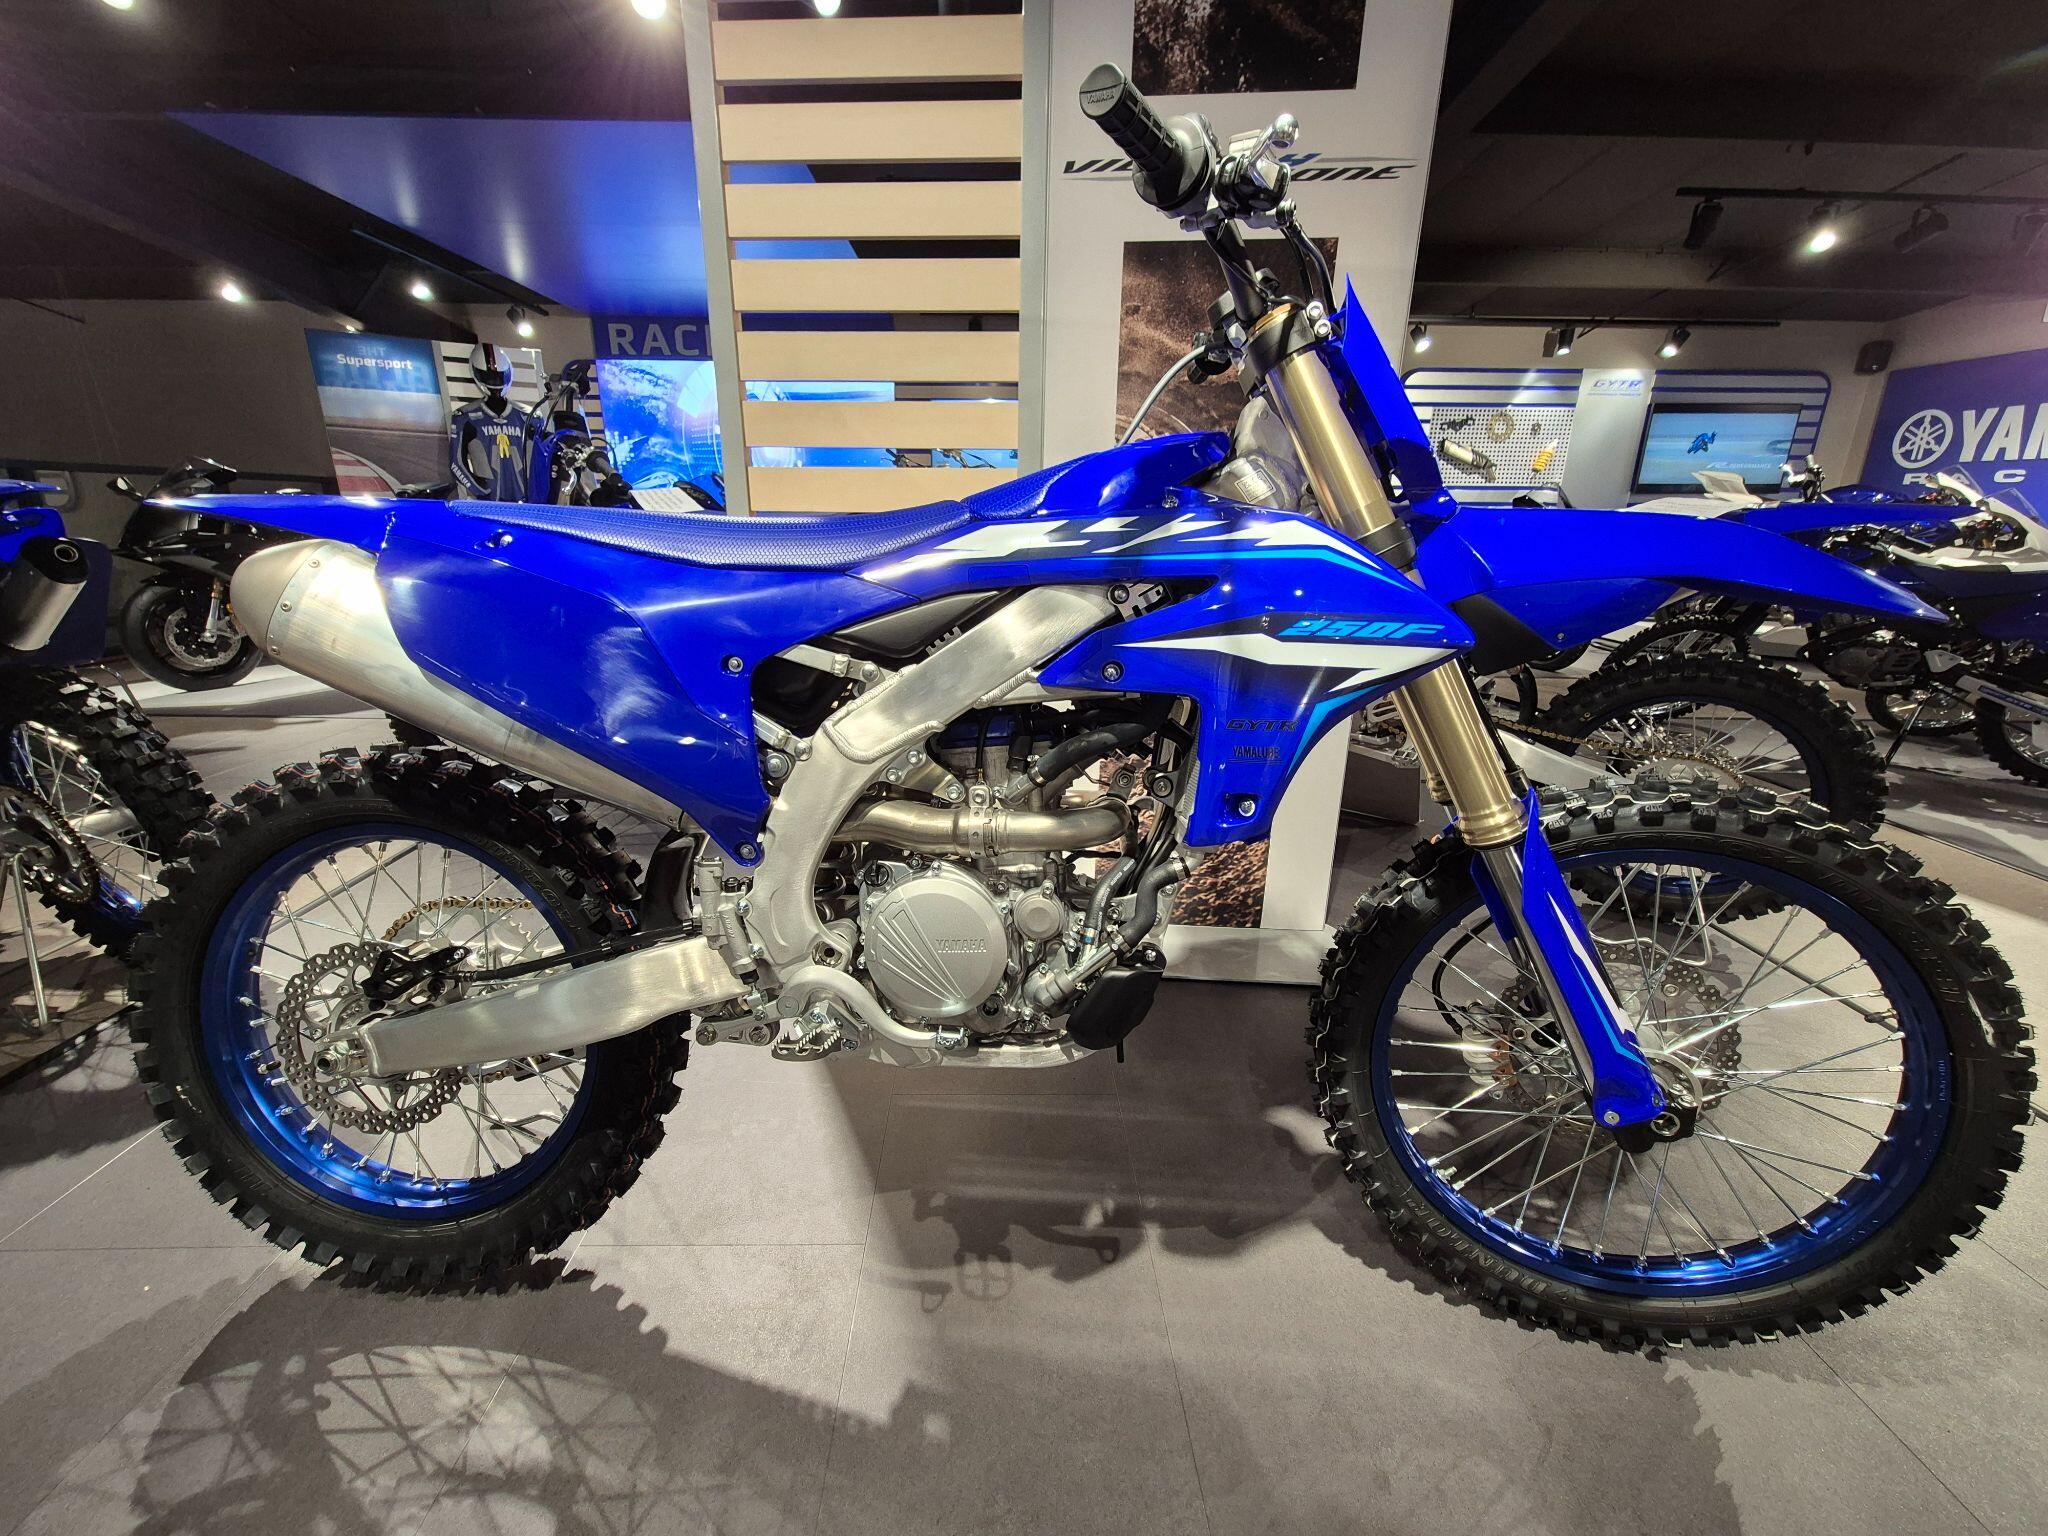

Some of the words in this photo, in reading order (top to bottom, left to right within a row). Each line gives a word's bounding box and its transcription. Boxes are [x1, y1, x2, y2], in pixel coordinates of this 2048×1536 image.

[336, 353, 413, 370] Supersport
[1593, 379, 1643, 388] GYTR
[481, 425, 521, 437] YAMAHA
[1278, 620, 1445, 639] 250F
[1226, 719, 1298, 733] GYTR
[1232, 746, 1281, 759] YAMALUBE
[935, 938, 987, 953] YAMAHA
